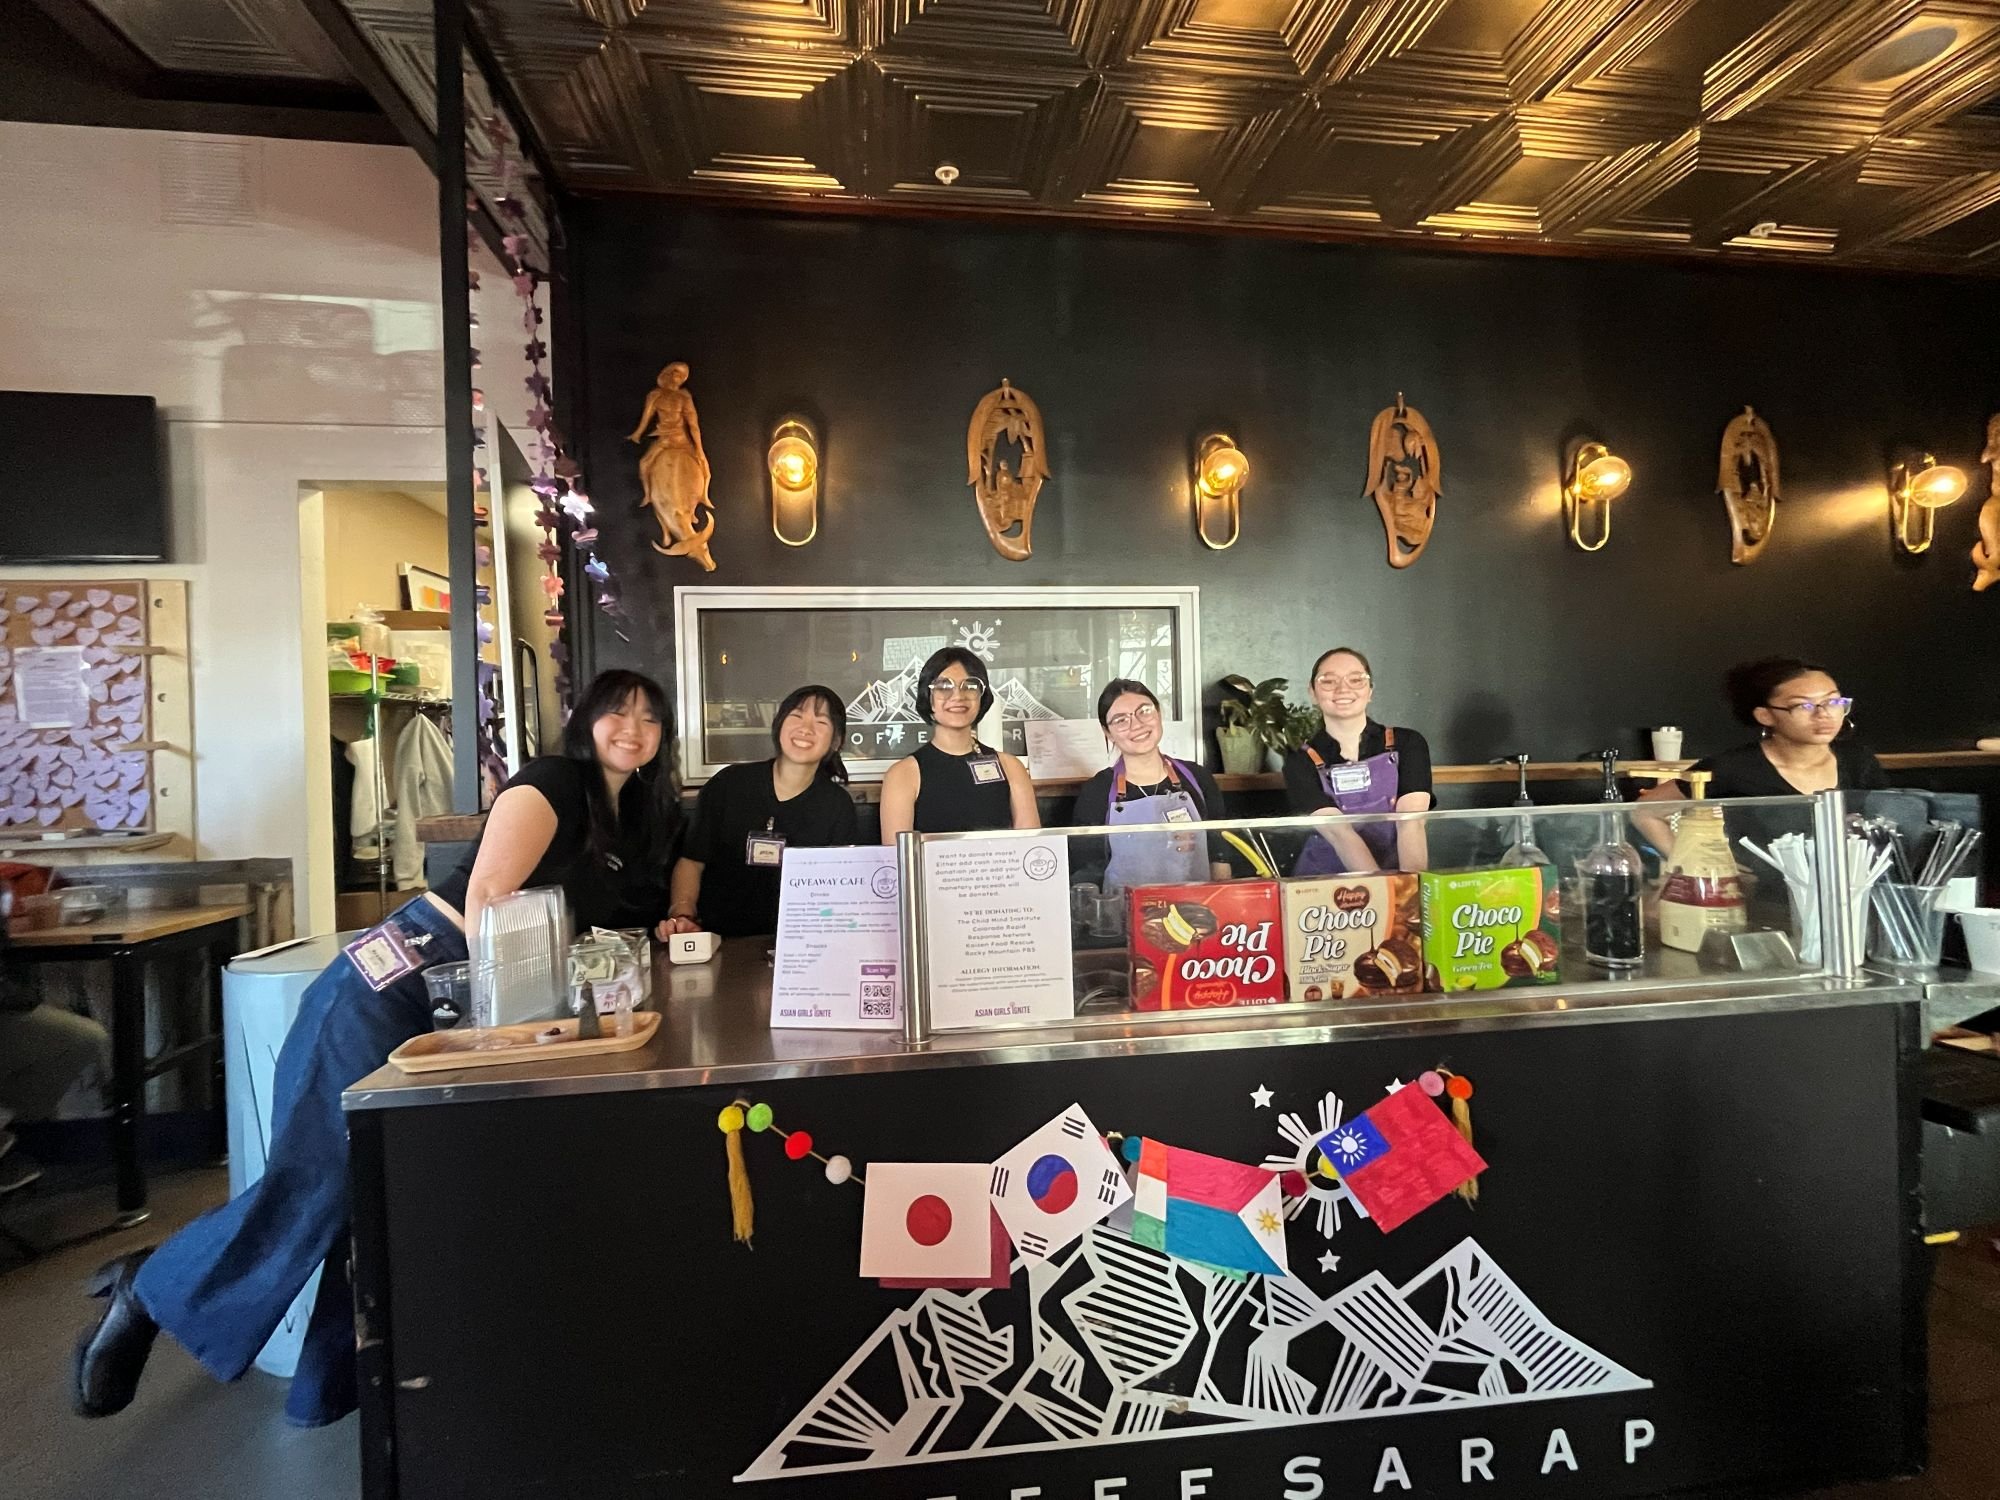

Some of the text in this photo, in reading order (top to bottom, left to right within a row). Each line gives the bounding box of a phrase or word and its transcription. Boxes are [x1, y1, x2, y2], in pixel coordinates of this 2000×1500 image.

[935, 868, 966, 876] donation
[1005, 866, 1020, 875] your
[790, 877, 865, 888] GIVEAWAY CAFE
[939, 884, 972, 892] monetary
[974, 883, 1006, 891] proceeds
[1298, 905, 1377, 933] Choco
[1452, 902, 1523, 930] Choco
[1221, 921, 1274, 953] Pie
[1300, 933, 1347, 963] Pie
[1452, 930, 1495, 958] Pie
[1181, 954, 1276, 985] Choco
[1299, 963, 1351, 975] Black Sugar
[1452, 963, 1478, 974] Green
[1193, 988, 1231, 1001] Happy
[780, 1008, 831, 1017] ASIAN GIRLS IGNITE
[975, 1005, 1030, 1017] ASIAN GIRLS IGNITE
[1283, 1418, 1657, 1500] SARAP
